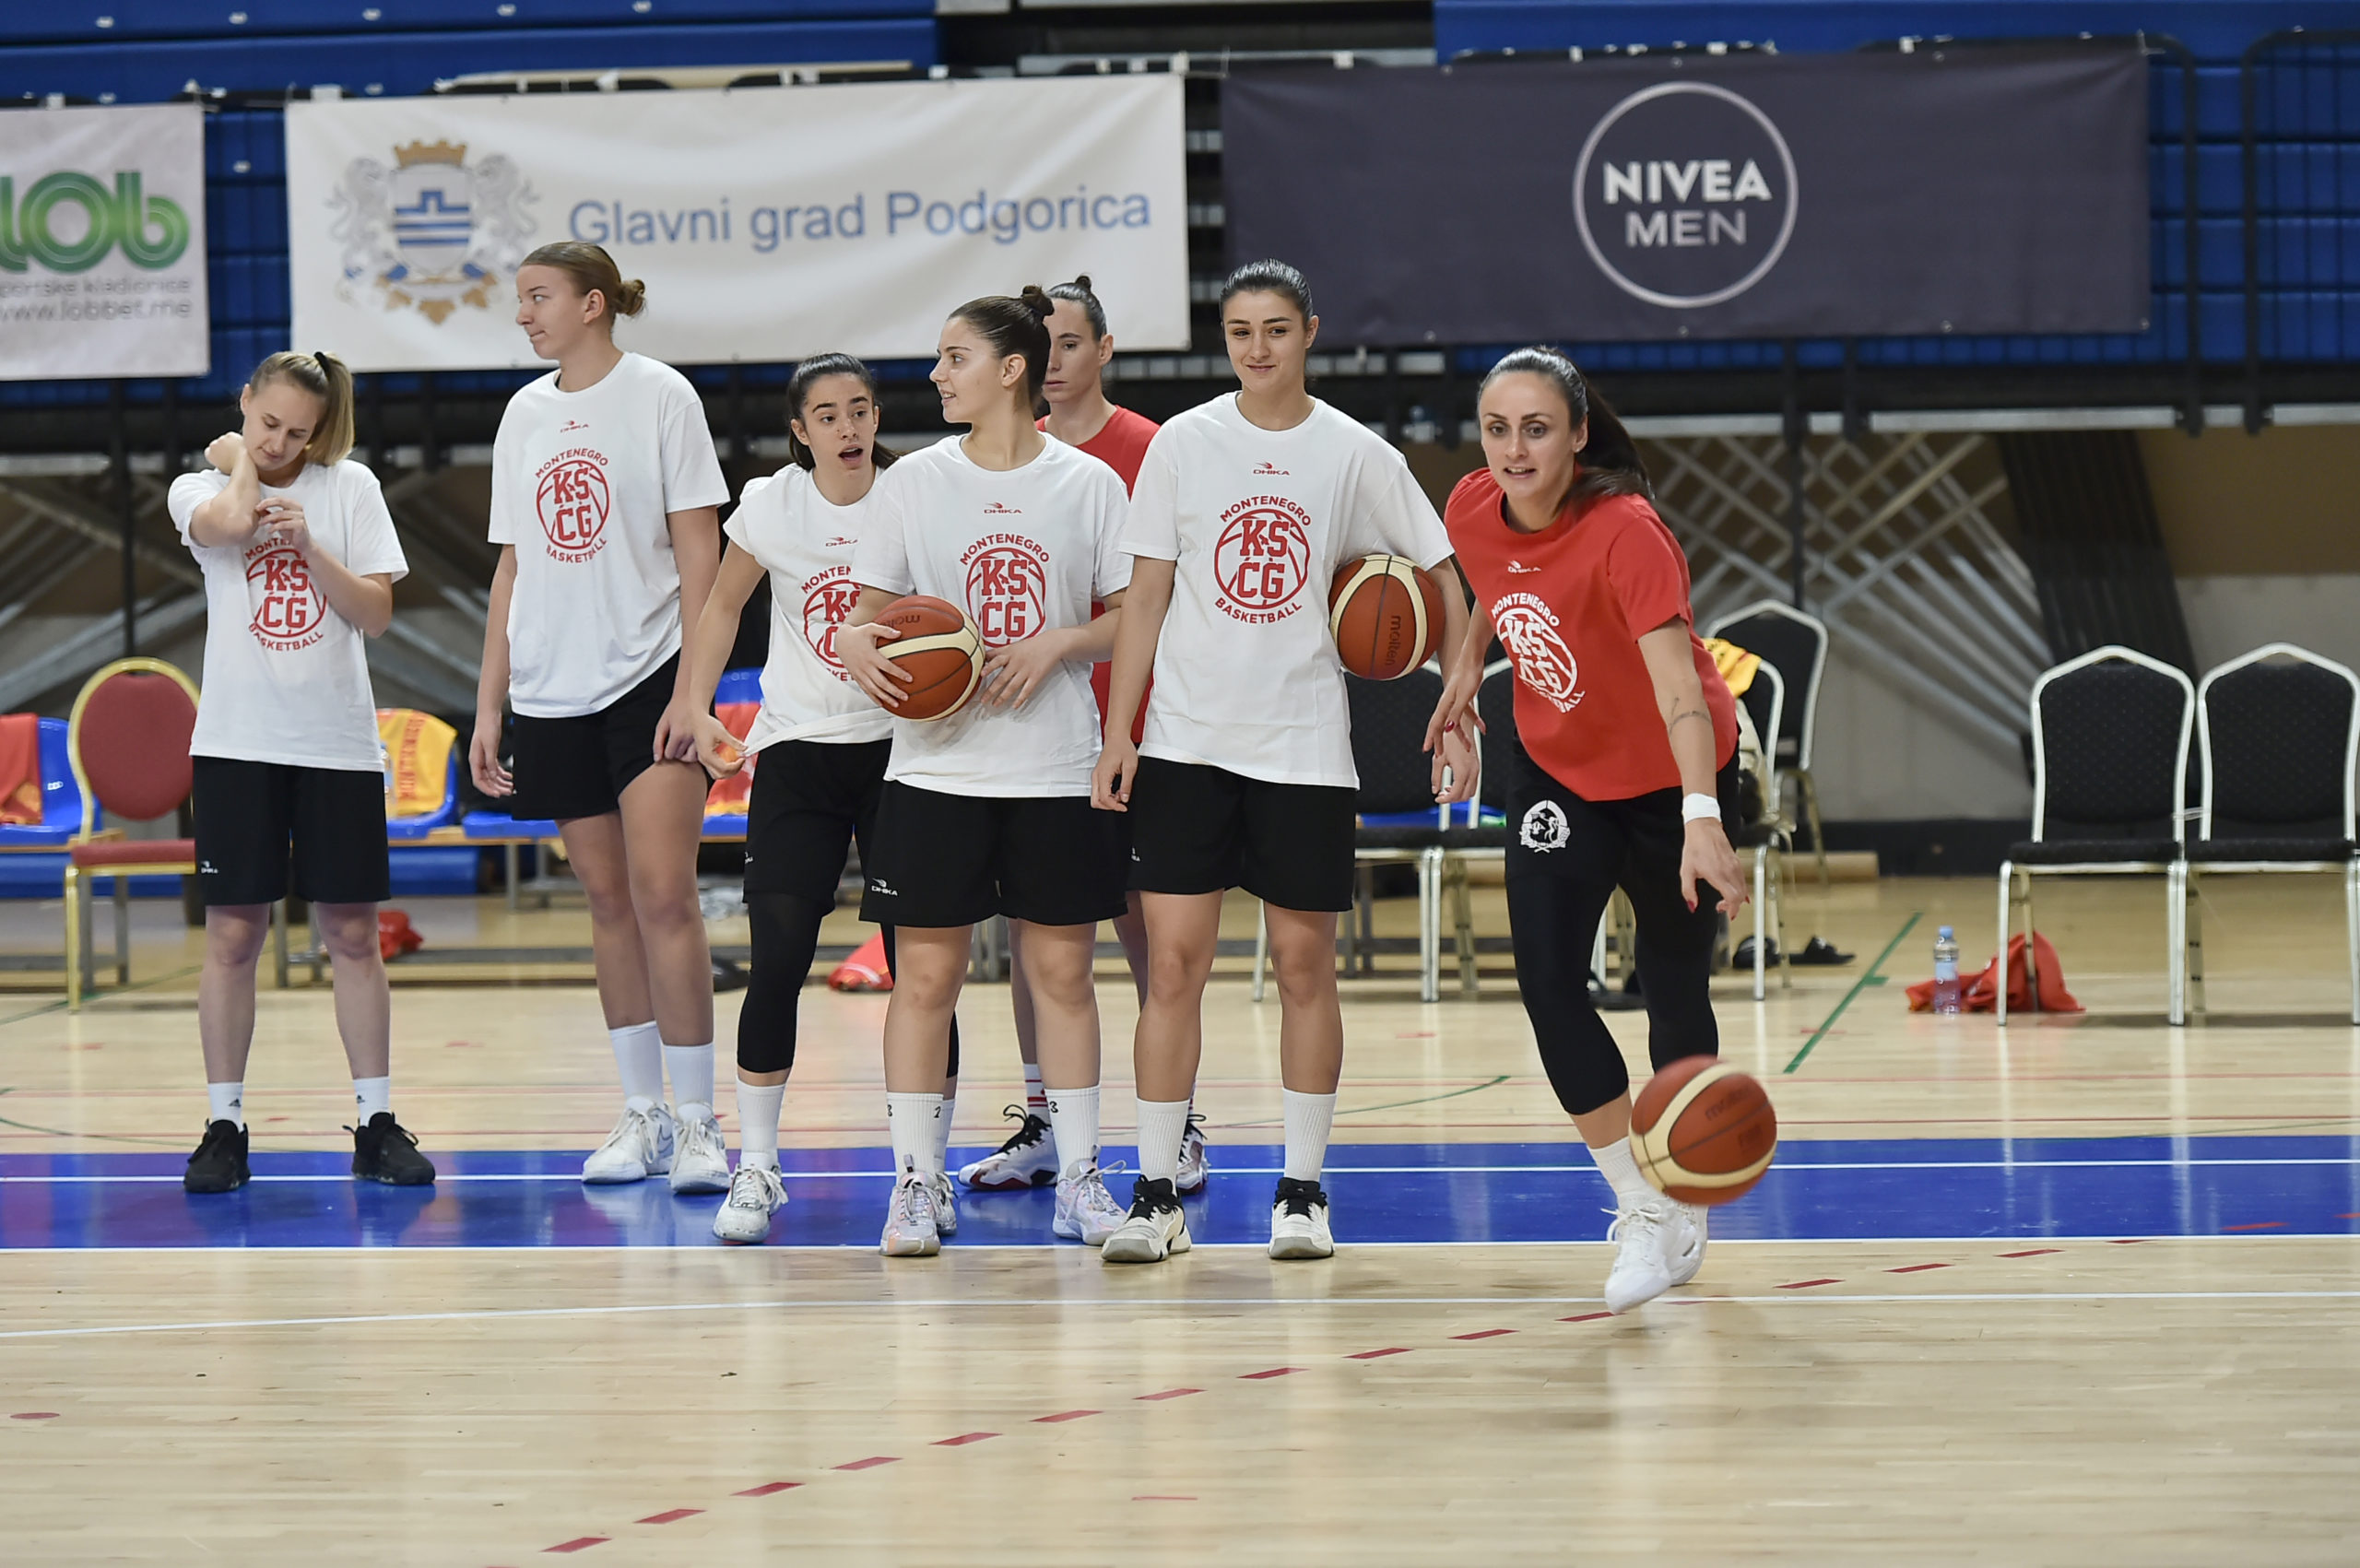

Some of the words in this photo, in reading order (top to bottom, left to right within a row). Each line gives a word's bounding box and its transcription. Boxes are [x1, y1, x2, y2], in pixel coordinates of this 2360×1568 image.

[1603, 159, 1773, 204] NIVEA
[569, 196, 731, 246] Glavni
[749, 194, 866, 253] grad
[888, 185, 1151, 244] Podgorica
[1625, 209, 1747, 247] MEN
[534, 447, 608, 479] MONTENEGRO
[553, 466, 590, 505] KS
[555, 504, 593, 542] CG
[1220, 495, 1312, 526] MONTENEGRO
[245, 537, 291, 560] MONTE
[960, 533, 1050, 566] MONTENEGRO
[1239, 519, 1290, 558] KS
[264, 559, 309, 592] KS
[801, 565, 852, 595] MONTEN
[980, 559, 1028, 596] KS
[1236, 561, 1286, 599] CG
[263, 595, 308, 629] CG
[981, 600, 1027, 638] CG
[1214, 596, 1303, 624] BASKETBALL
[1491, 592, 1561, 628] MONTENEGRO
[248, 622, 324, 652] BASKETBALL
[1385, 615, 1401, 666] molten
[1504, 619, 1549, 658] KS
